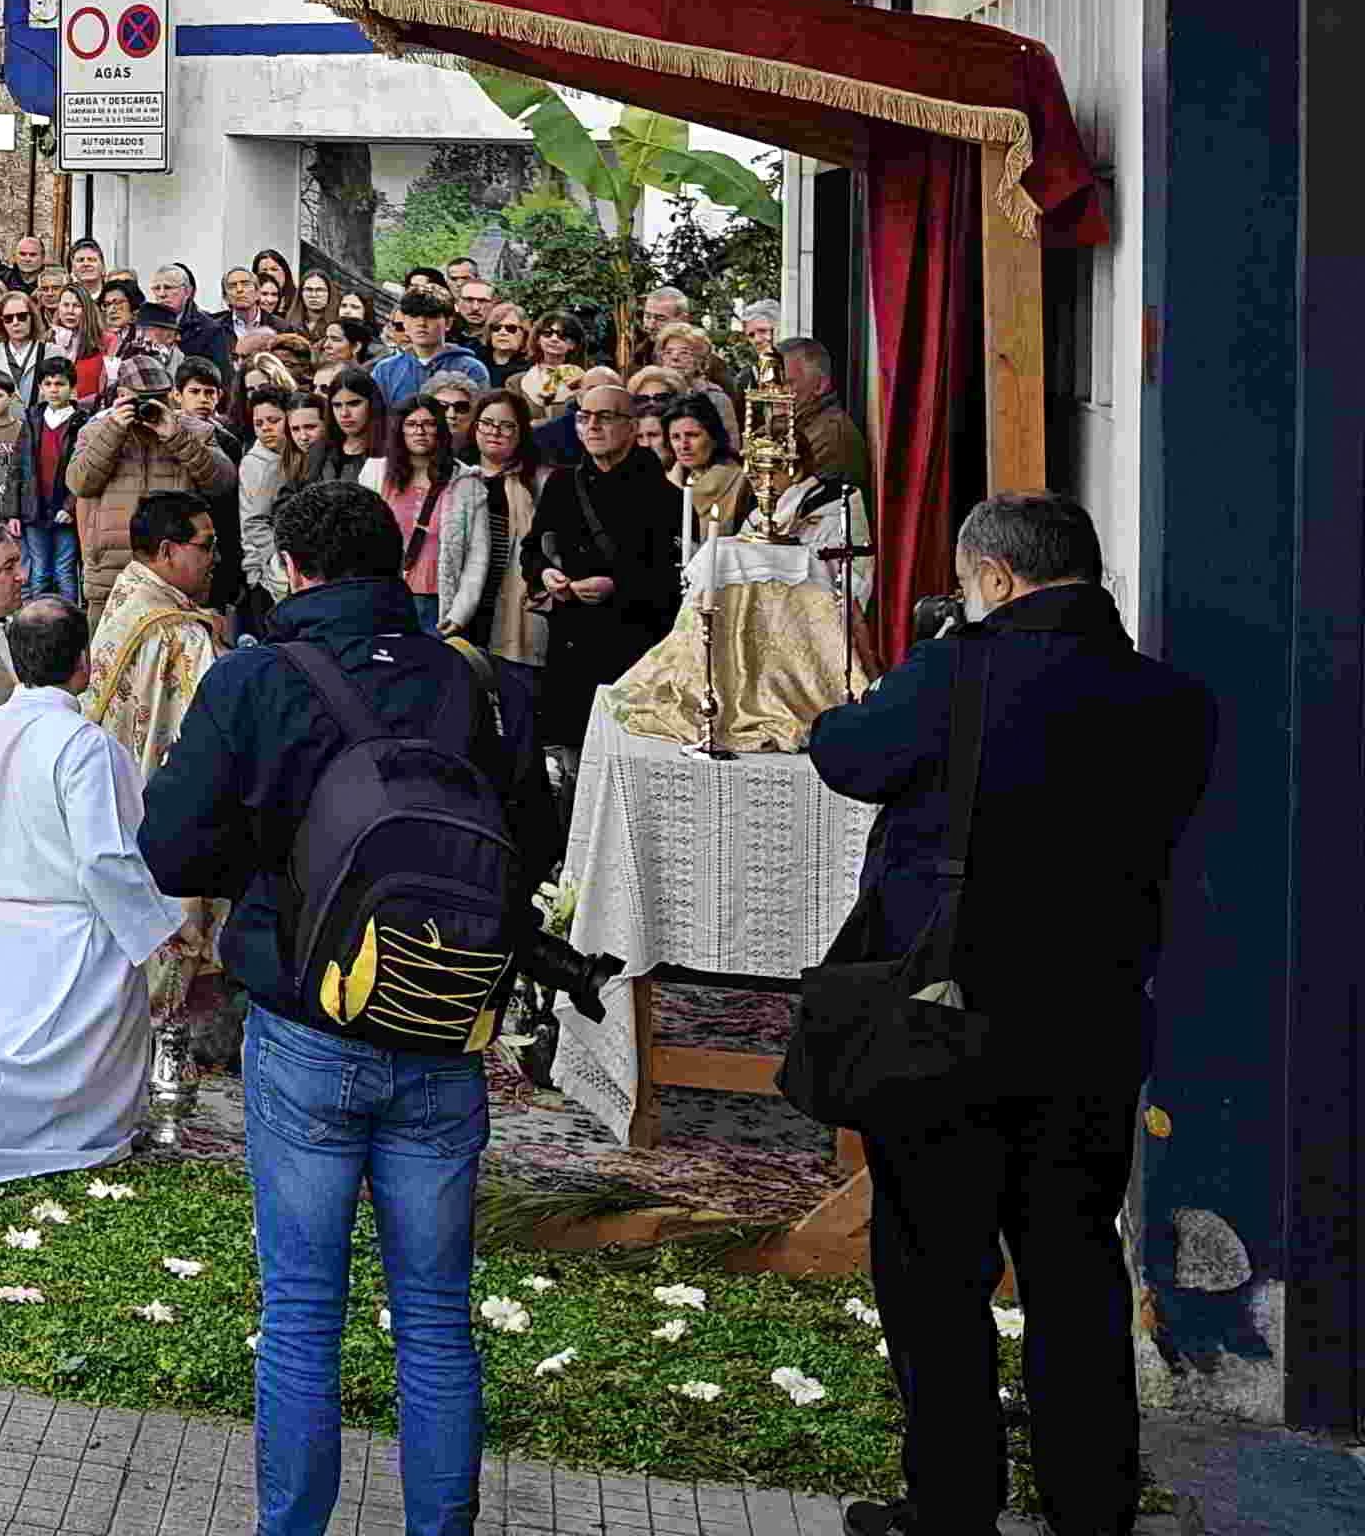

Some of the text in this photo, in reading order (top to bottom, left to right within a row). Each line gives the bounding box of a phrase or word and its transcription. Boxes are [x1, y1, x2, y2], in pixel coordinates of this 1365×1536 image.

[68, 95, 158, 106] CARGA Y DESCARGA
[81, 136, 144, 146] AUTORIZADOS
